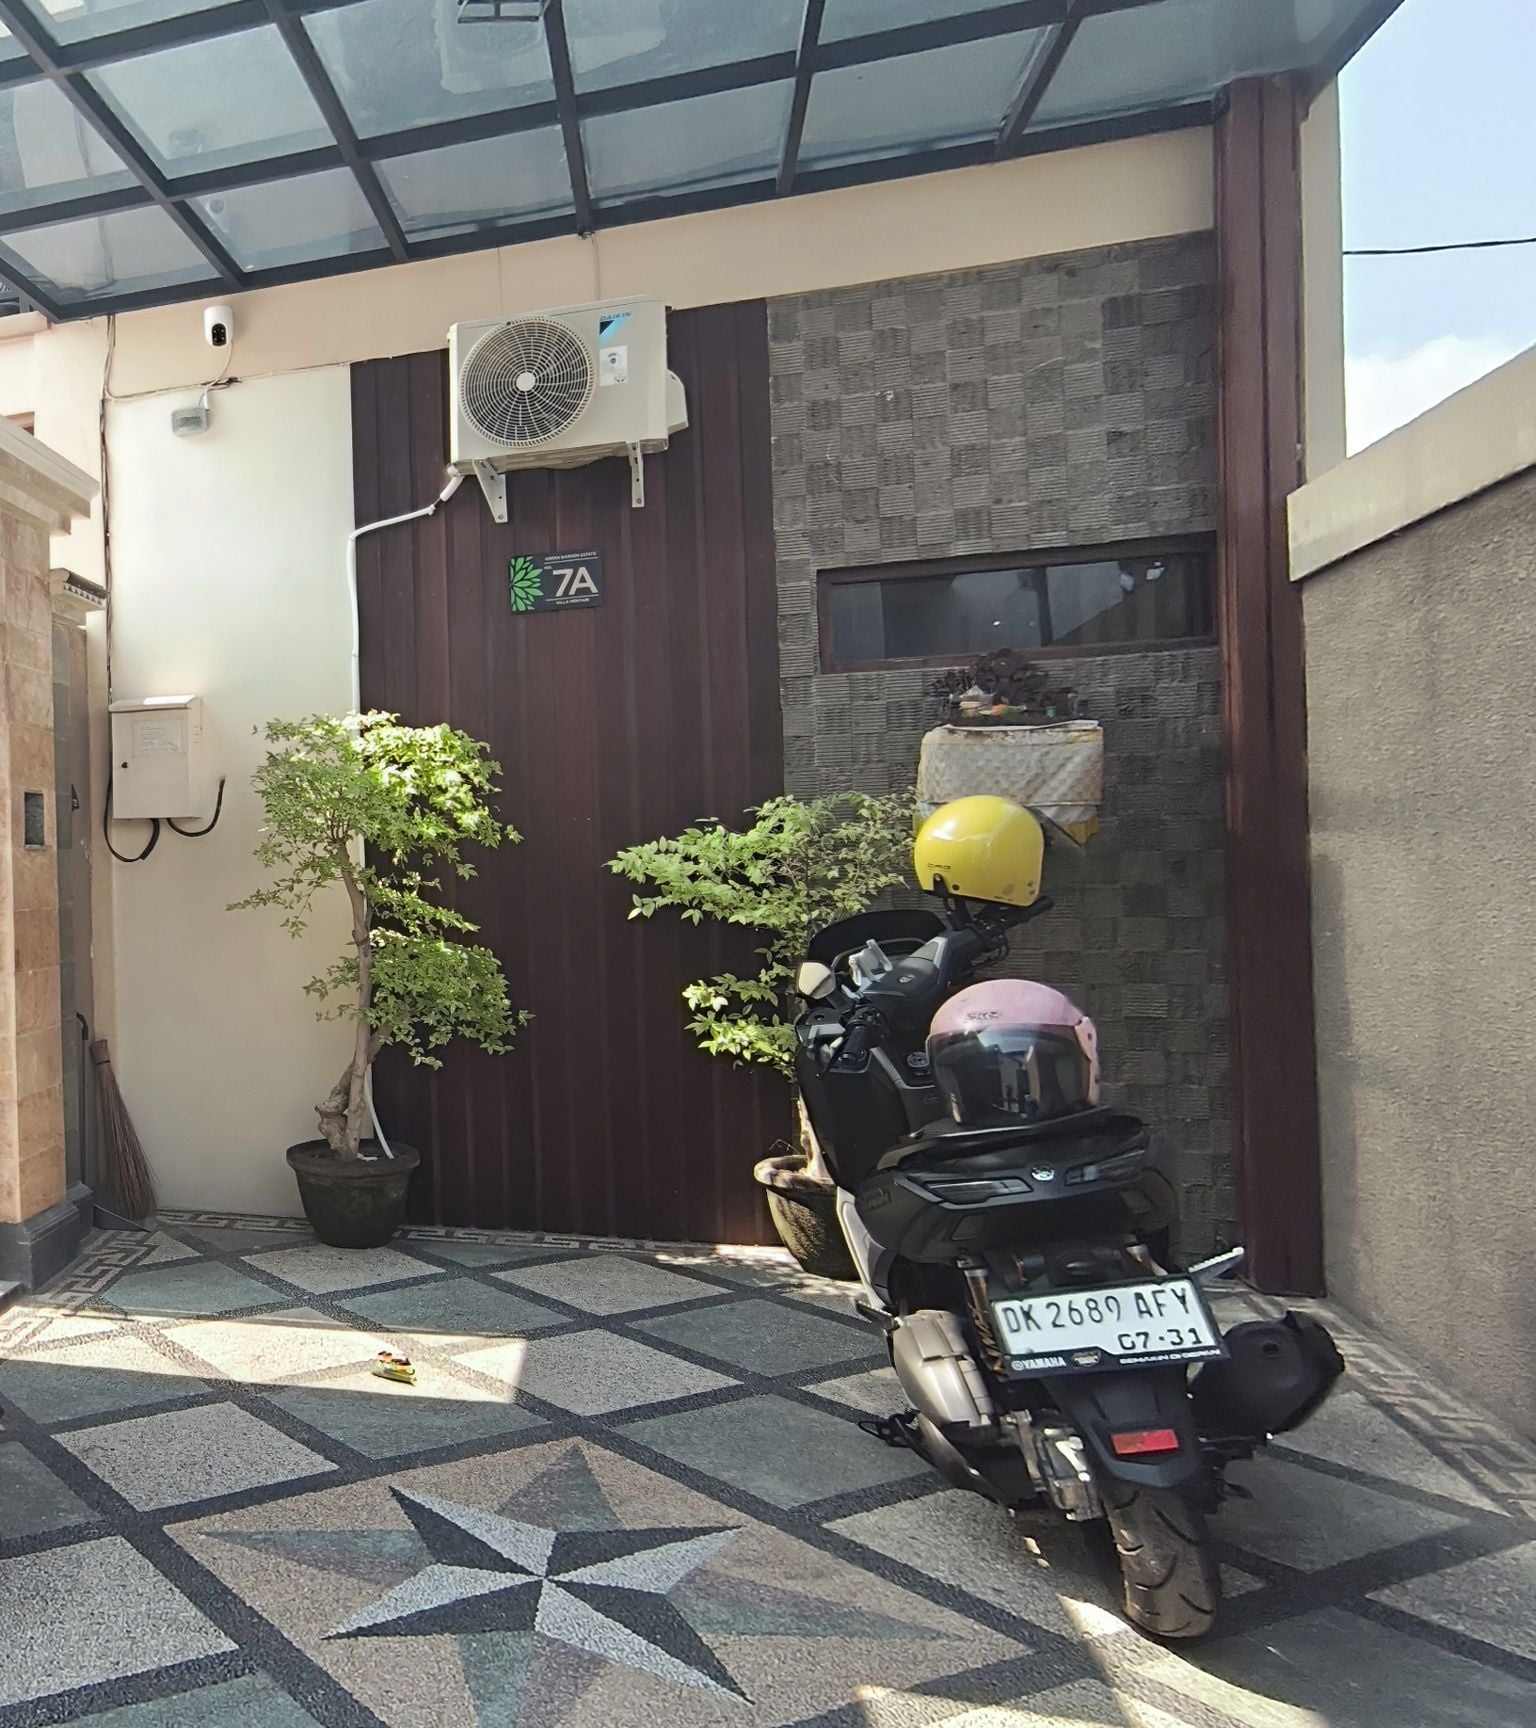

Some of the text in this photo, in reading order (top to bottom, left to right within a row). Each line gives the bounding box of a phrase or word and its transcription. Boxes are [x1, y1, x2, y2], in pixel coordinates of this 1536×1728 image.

[552, 566, 598, 597] 7A
[1001, 1287, 1191, 1334] DK 2689 AFY
[1023, 1356, 1067, 1370] YAMAHA
